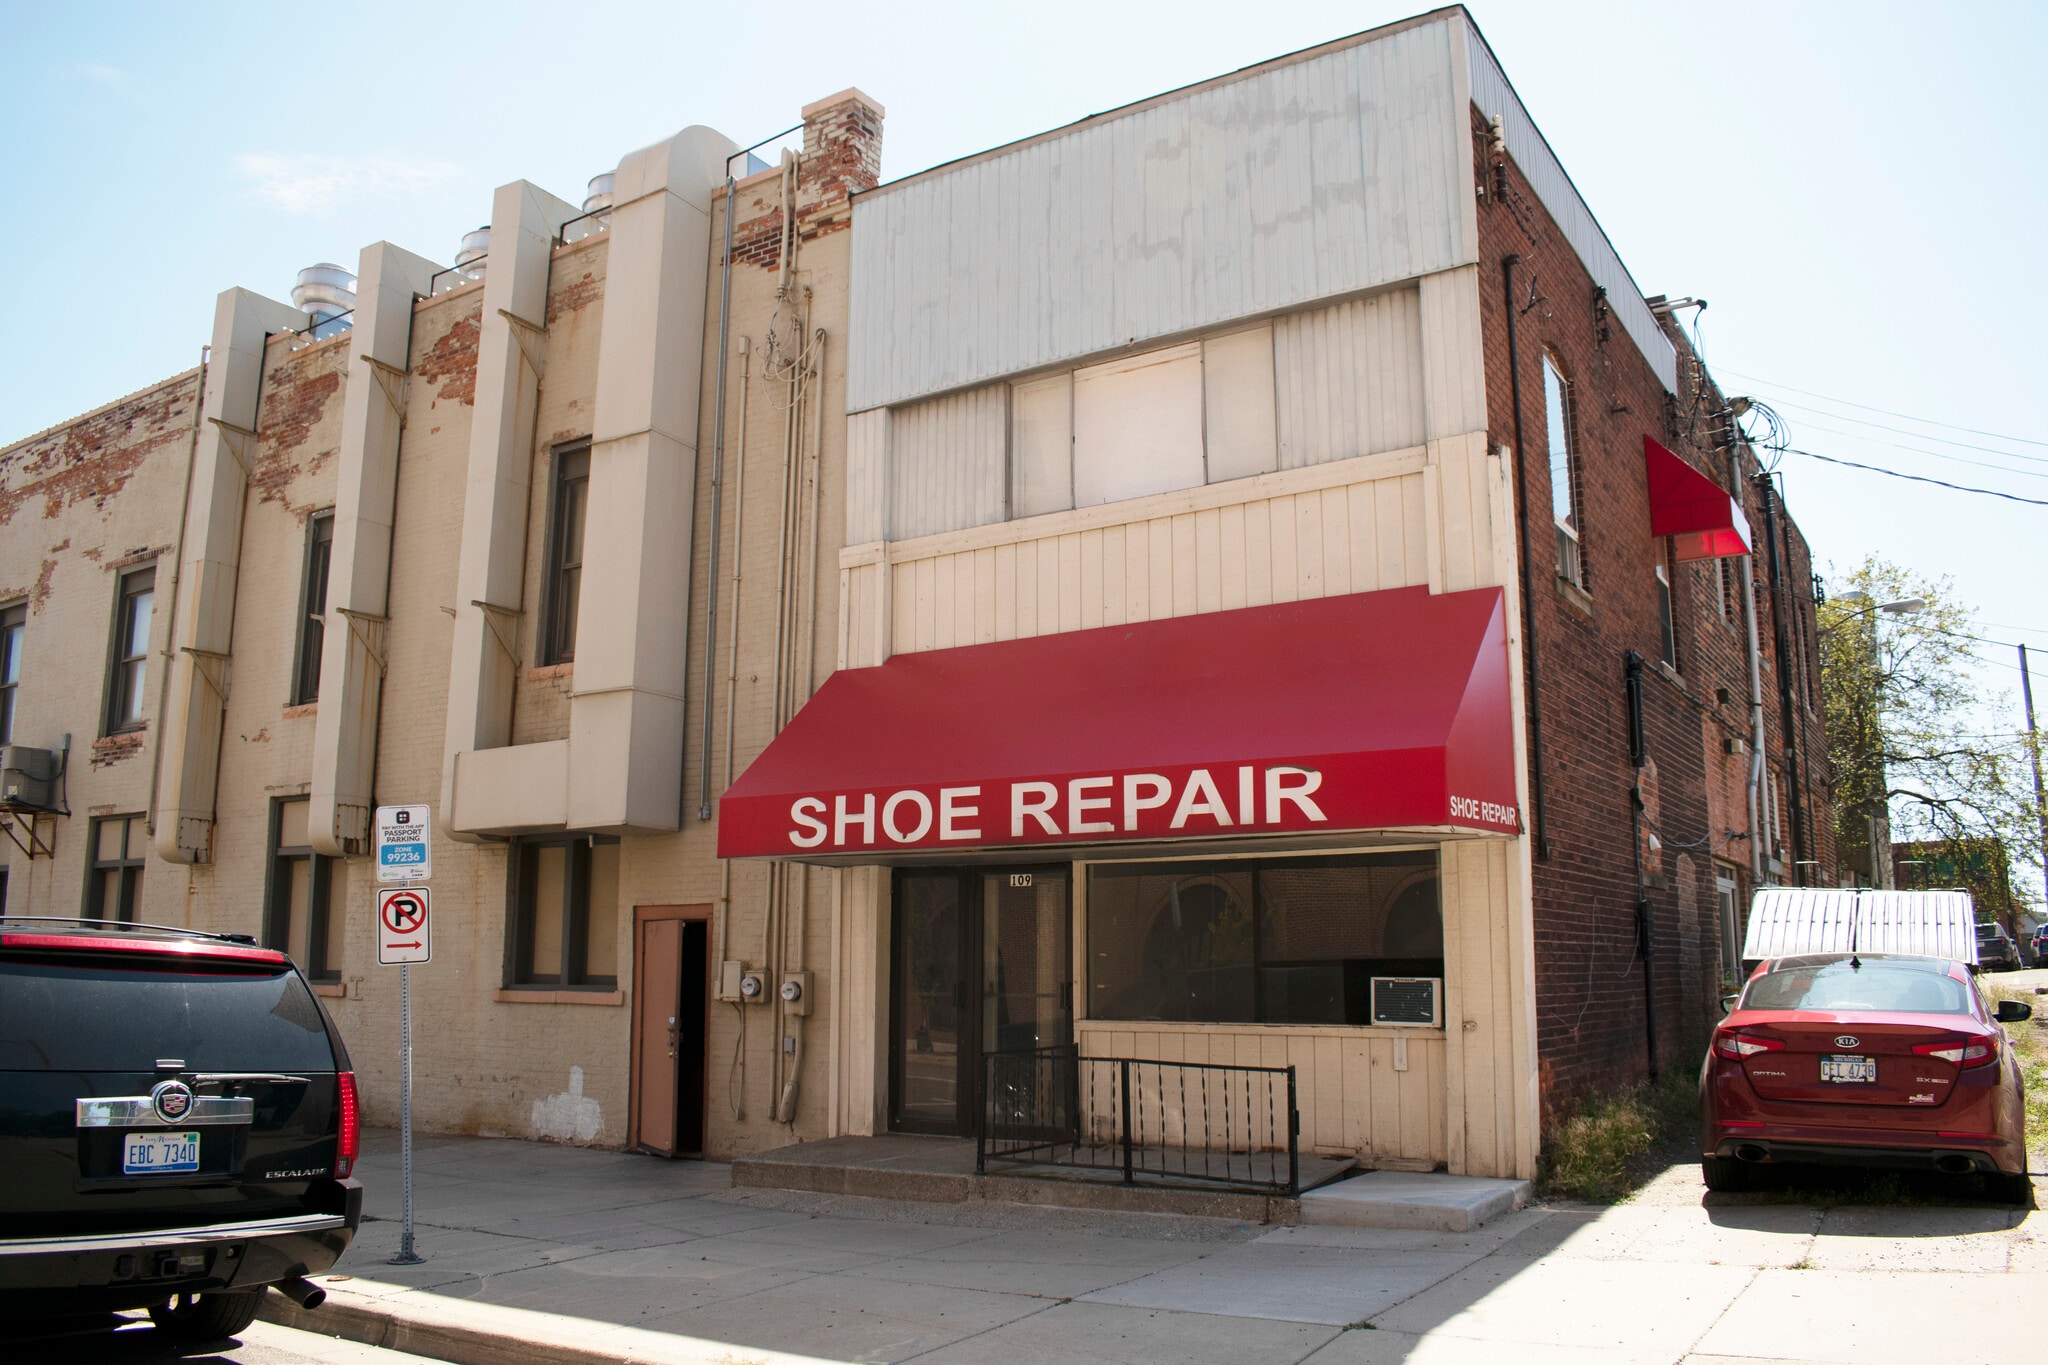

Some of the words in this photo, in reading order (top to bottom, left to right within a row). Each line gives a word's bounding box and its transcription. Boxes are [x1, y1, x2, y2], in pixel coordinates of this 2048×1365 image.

[788, 785, 982, 849] SHOE
[1011, 765, 1328, 837] REPAIR
[1450, 795, 1480, 820] SHOE
[1481, 801, 1517, 826] REPAIR
[384, 829, 422, 837] PASSPORT
[387, 852, 420, 863] 99236
[1011, 875, 1031, 886] 109
[1838, 1037, 1856, 1045] KIA
[129, 1144, 155, 1165] EBC
[163, 1143, 196, 1163] 7340
[265, 1167, 327, 1179] ESCALADE
